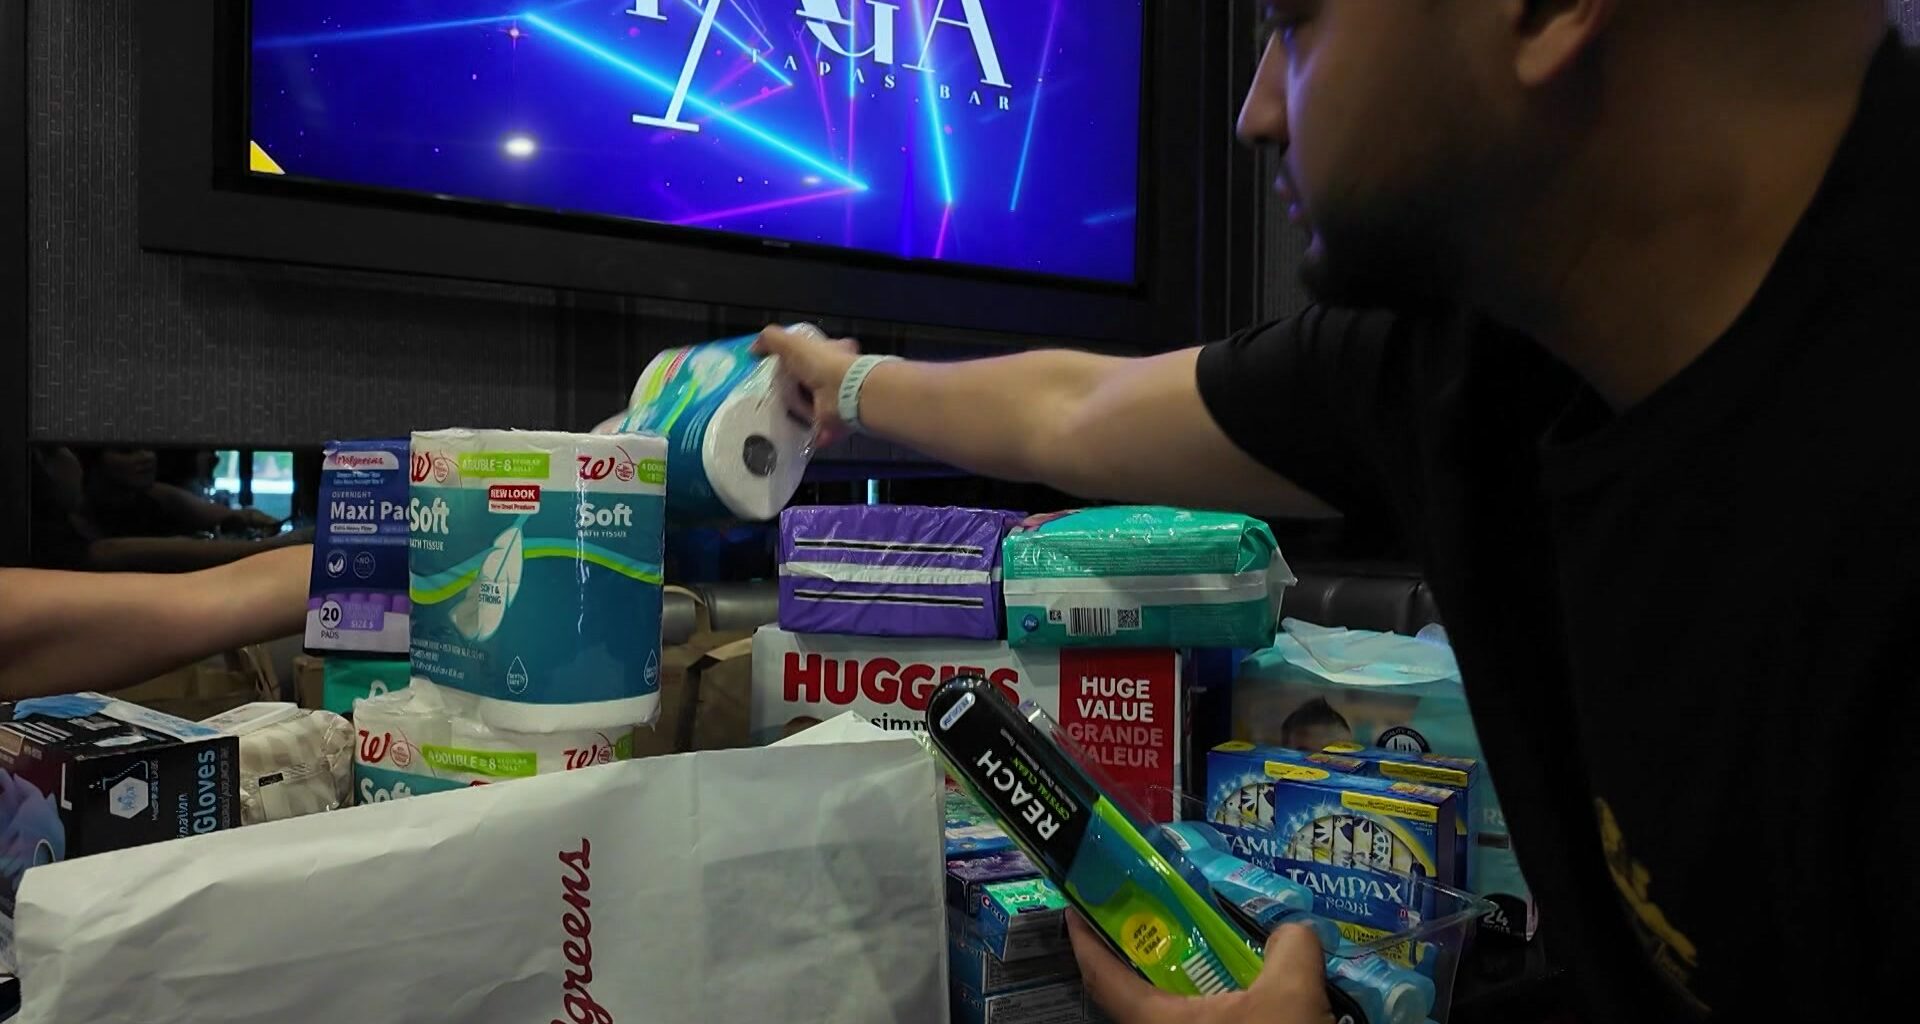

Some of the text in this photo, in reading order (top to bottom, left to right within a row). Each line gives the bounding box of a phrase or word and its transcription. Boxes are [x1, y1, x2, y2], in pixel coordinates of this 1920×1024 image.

[750, 47, 1012, 110] TAPAS BAR
[331, 490, 373, 499] OVERNIGHT
[490, 489, 536, 500] NEW LOOK
[330, 501, 374, 521] Maxi
[410, 497, 450, 535] Soft
[579, 502, 633, 528] Soft
[478, 593, 502, 605] STRONG
[322, 608, 340, 622] 20
[320, 631, 340, 641] PADS
[784, 652, 1020, 711] HUGGS
[1080, 675, 1151, 700] HUGE
[1076, 698, 1155, 724] VALUE
[1066, 722, 1164, 748] GRANDE
[1081, 744, 1160, 769] ALEUR
[192, 746, 218, 836] Gloves
[976, 747, 1061, 842] REACH
[1286, 867, 1405, 903] TAMPAX
[551, 837, 613, 1024] greens
